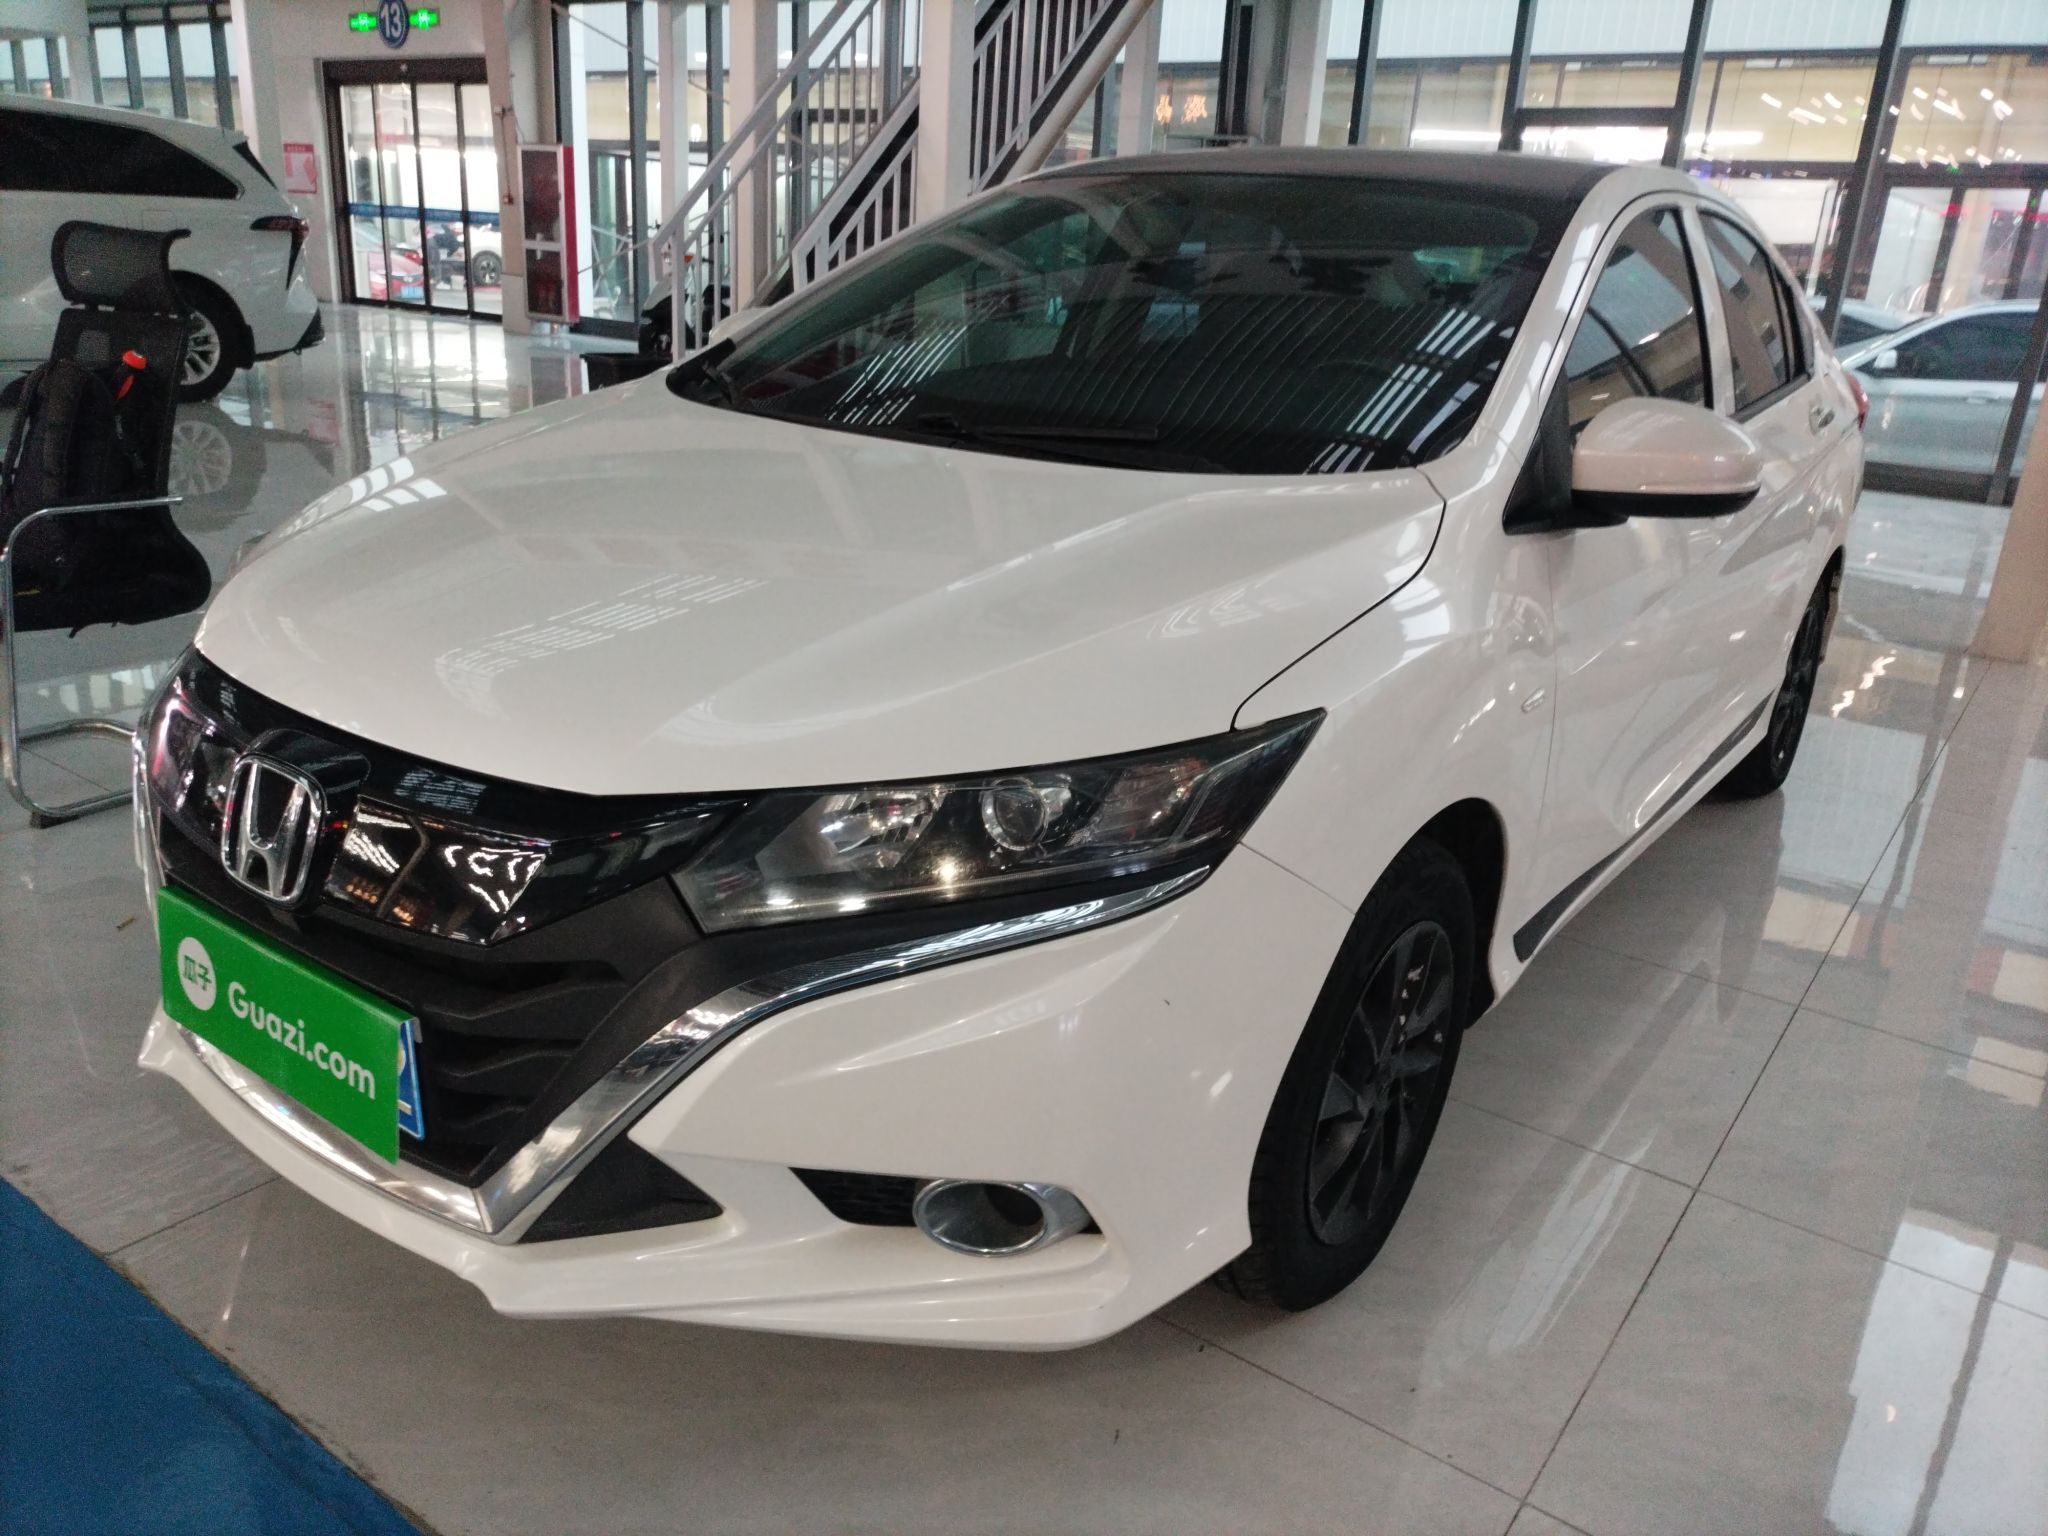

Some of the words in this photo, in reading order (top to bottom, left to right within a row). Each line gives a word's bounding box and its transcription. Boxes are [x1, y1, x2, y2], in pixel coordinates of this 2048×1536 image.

[380, 2, 402, 38] 13
[183, 954, 212, 992] 瓜子
[227, 981, 376, 1099] Guazi.com
